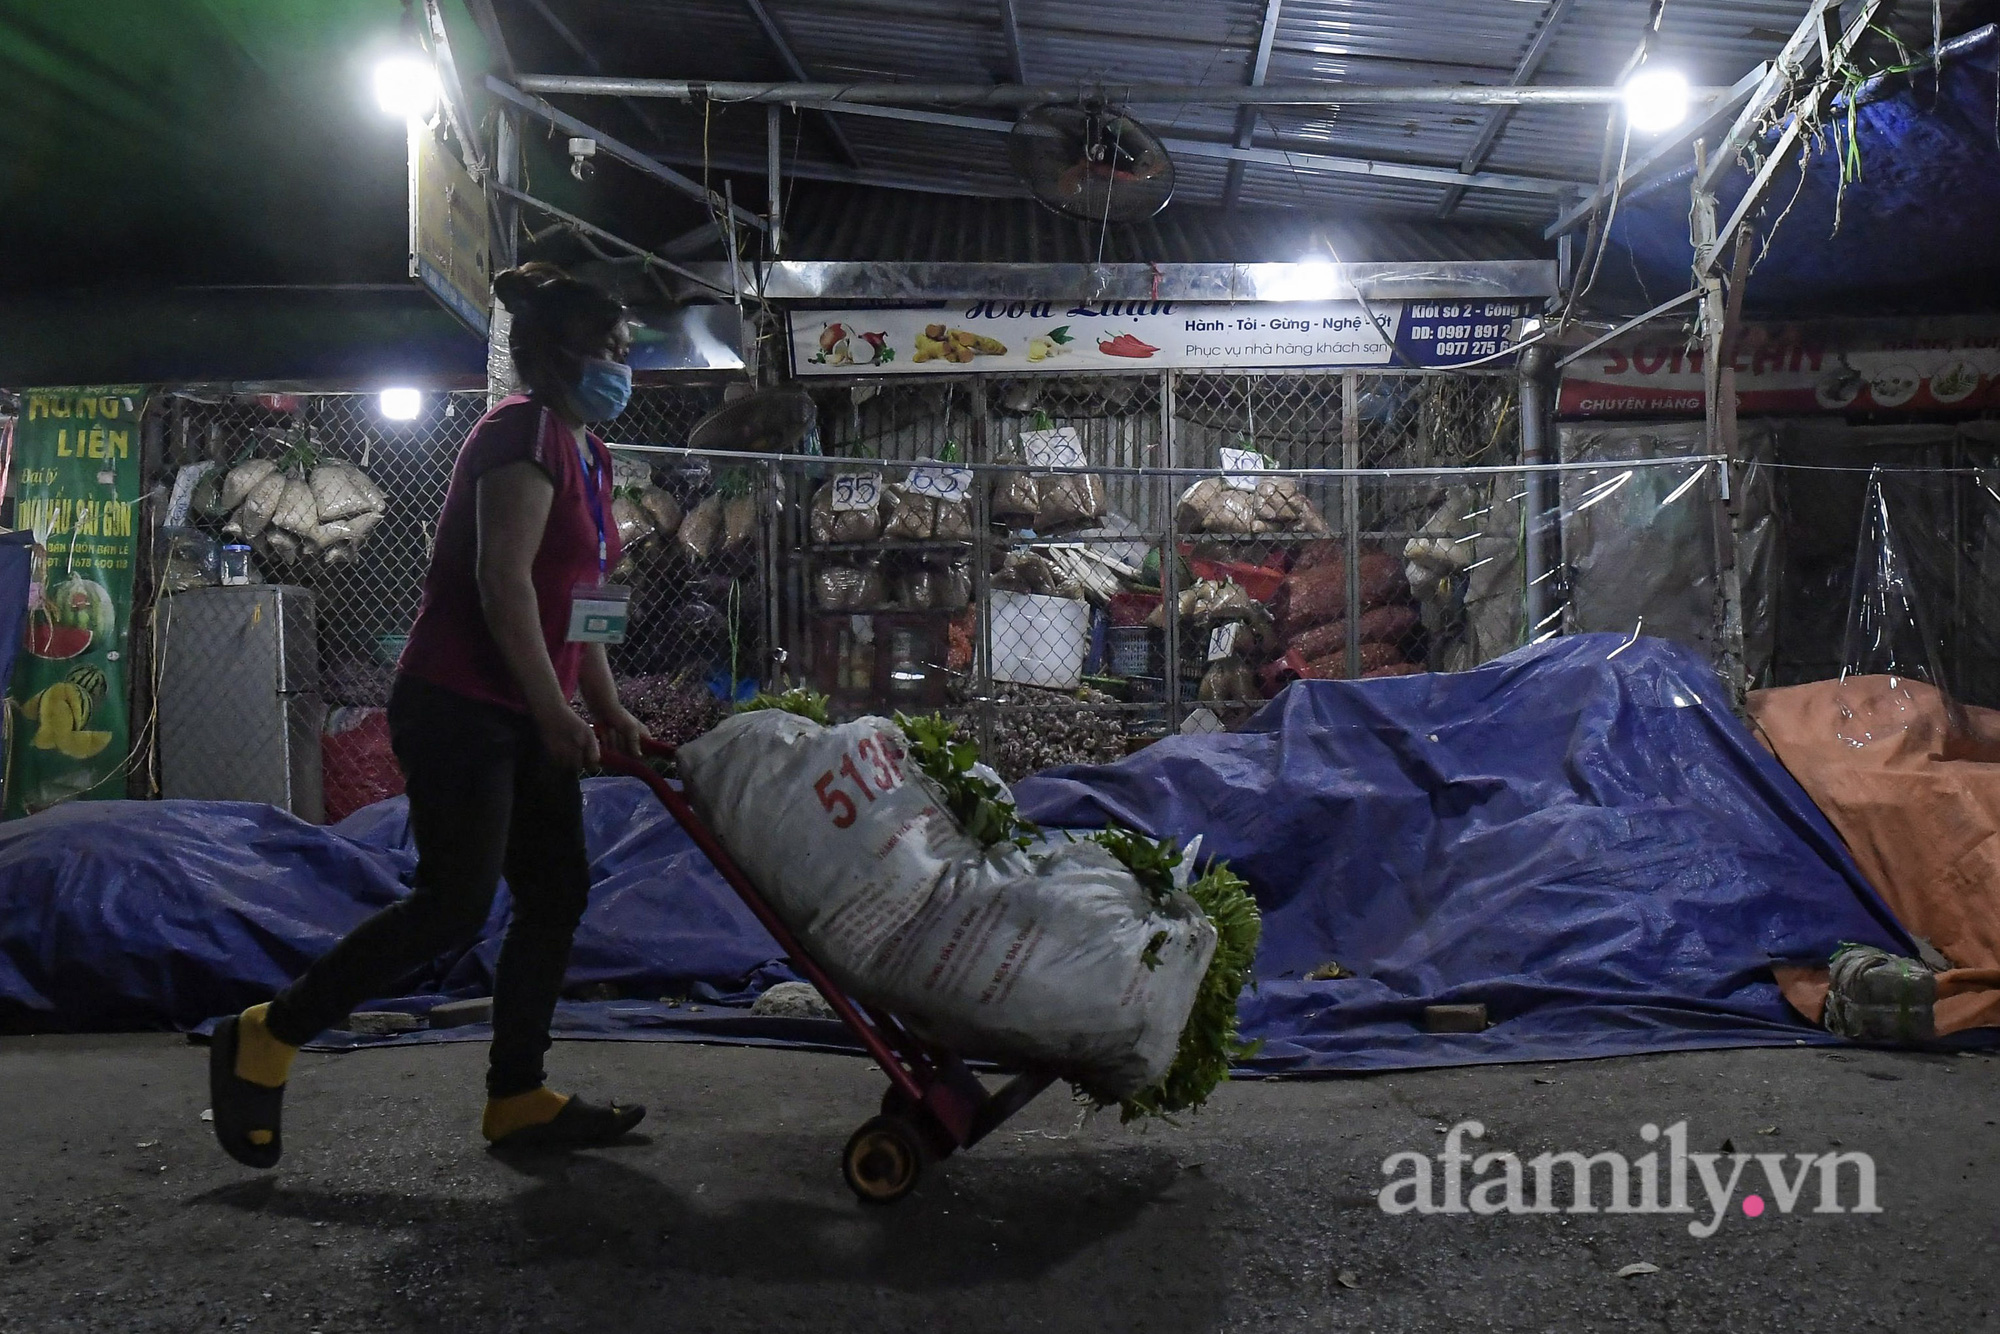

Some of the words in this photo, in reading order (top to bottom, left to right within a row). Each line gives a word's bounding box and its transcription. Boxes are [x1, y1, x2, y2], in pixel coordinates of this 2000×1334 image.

[1462, 304, 1473, 318] 2
[1185, 319, 1224, 332] Hành
[1236, 317, 1258, 331] Tỏi
[1269, 318, 1311, 332] Gừng
[1323, 316, 1362, 333] Nghệ
[1437, 325, 1472, 339] 0987
[1474, 324, 1499, 339] 891
[1185, 344, 1221, 358] Phục
[1224, 346, 1241, 358] vụ
[1245, 343, 1272, 355] nhà
[1275, 342, 1313, 356] hàng
[1316, 341, 1360, 354] khách
[1363, 343, 1388, 357] sạn
[1436, 341, 1469, 356] 0977
[1471, 341, 1496, 355] 275
[1579, 396, 1646, 411] CHUYÊN
[1651, 394, 1700, 409] HÀNG
[57, 423, 129, 459] LIÊN
[836, 472, 876, 504] 55
